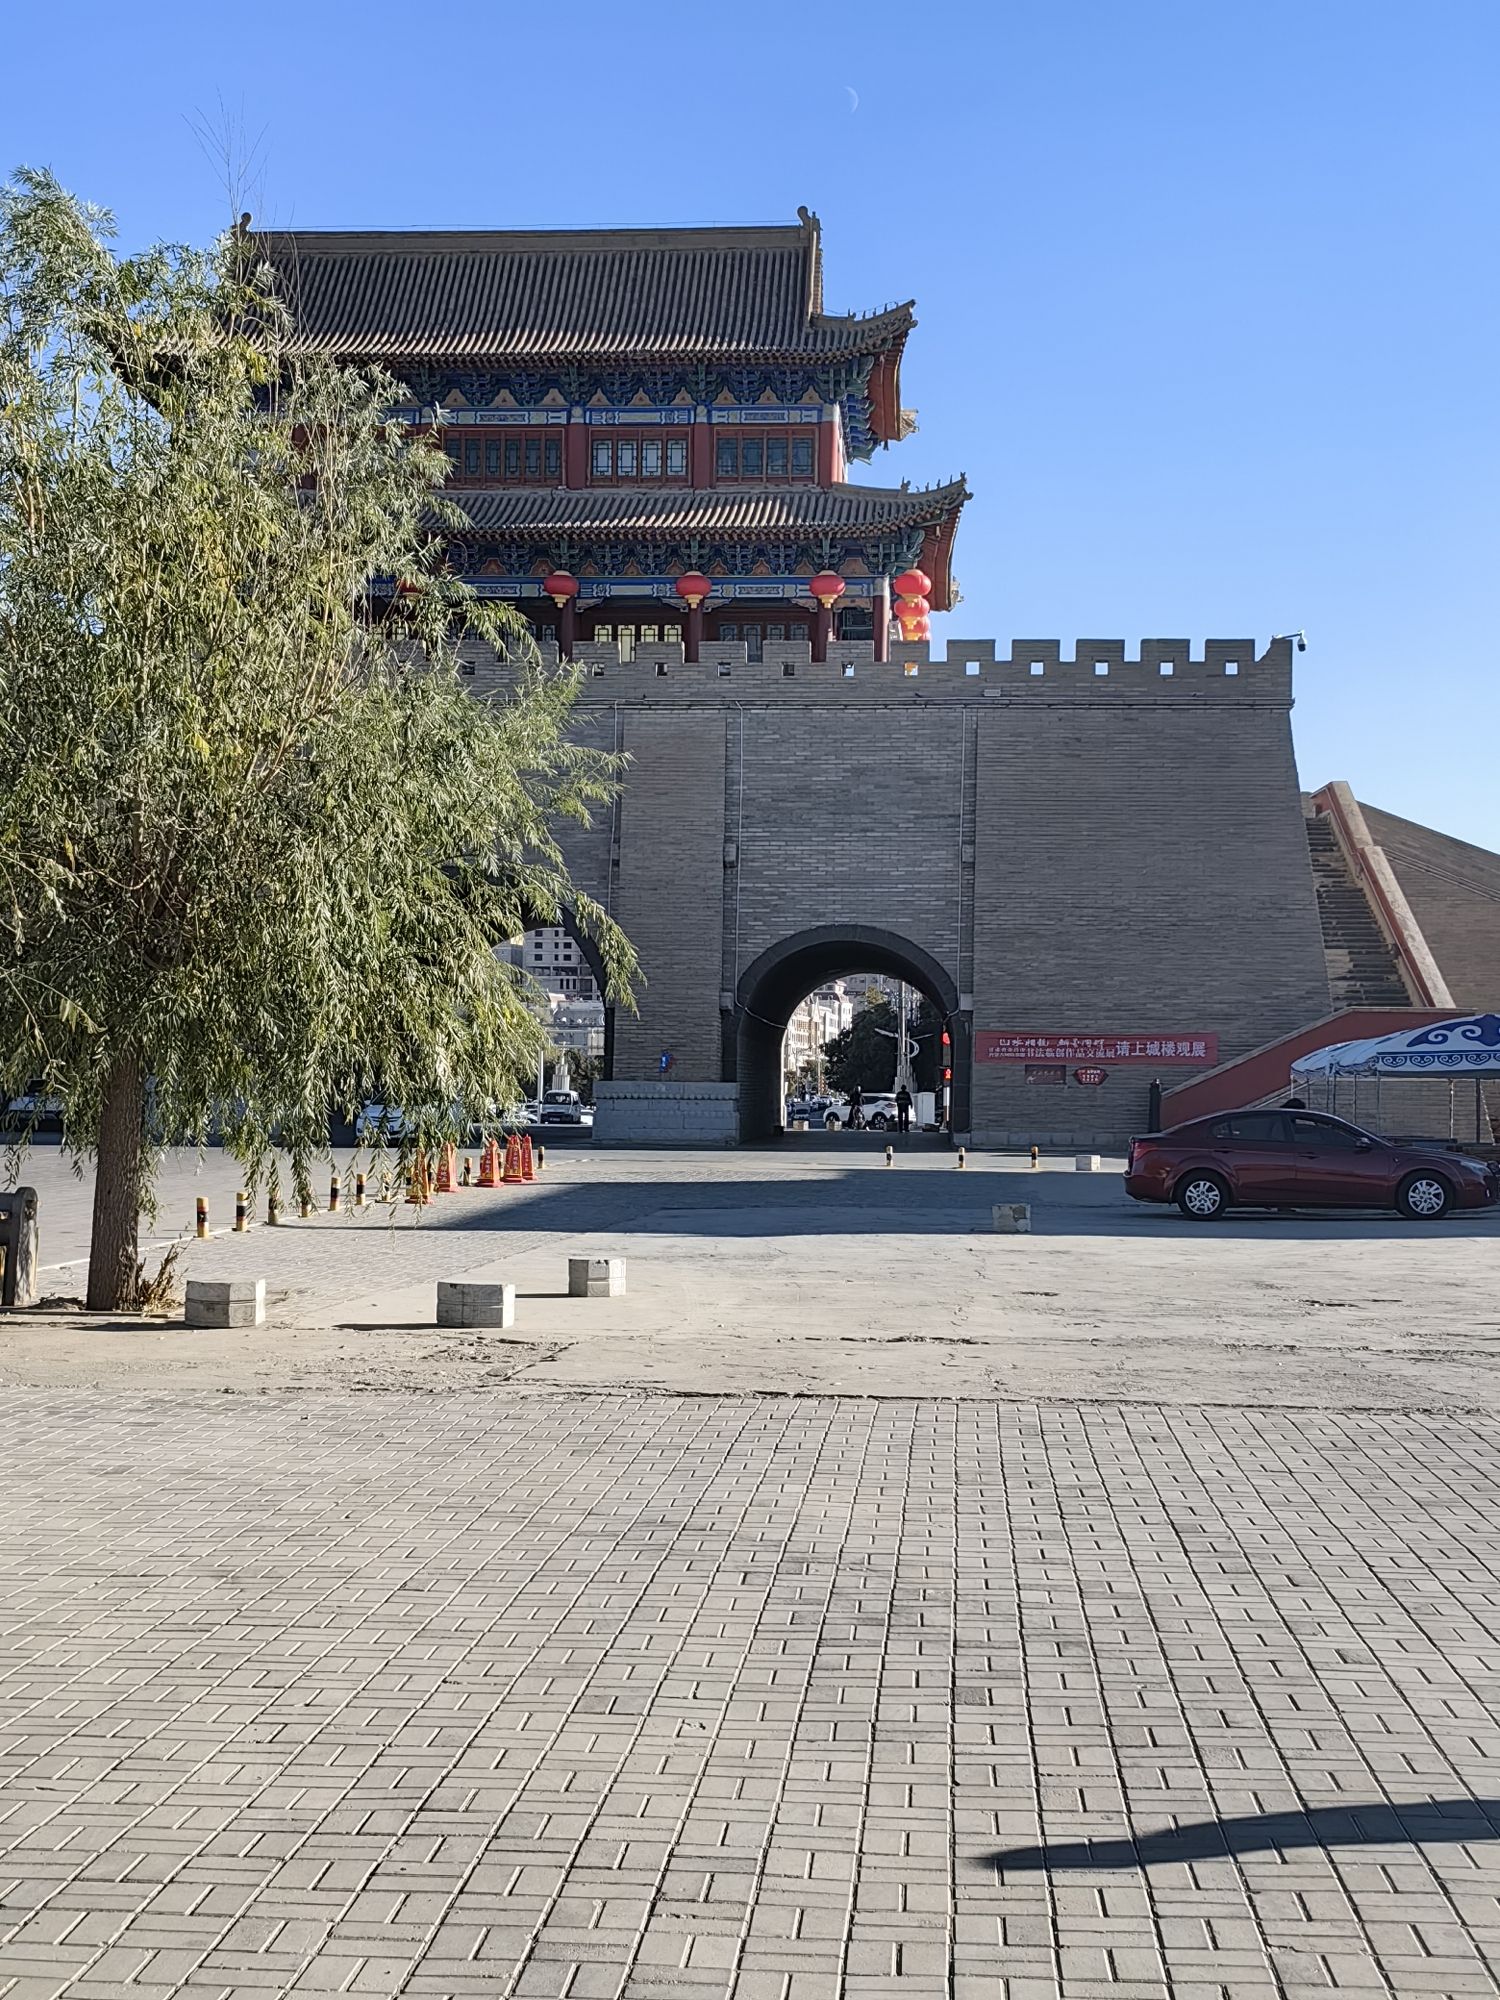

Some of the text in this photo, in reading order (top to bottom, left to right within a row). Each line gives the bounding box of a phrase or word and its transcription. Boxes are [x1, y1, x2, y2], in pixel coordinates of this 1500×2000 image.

[1116, 1040, 1206, 1057] 请上城楼观展
